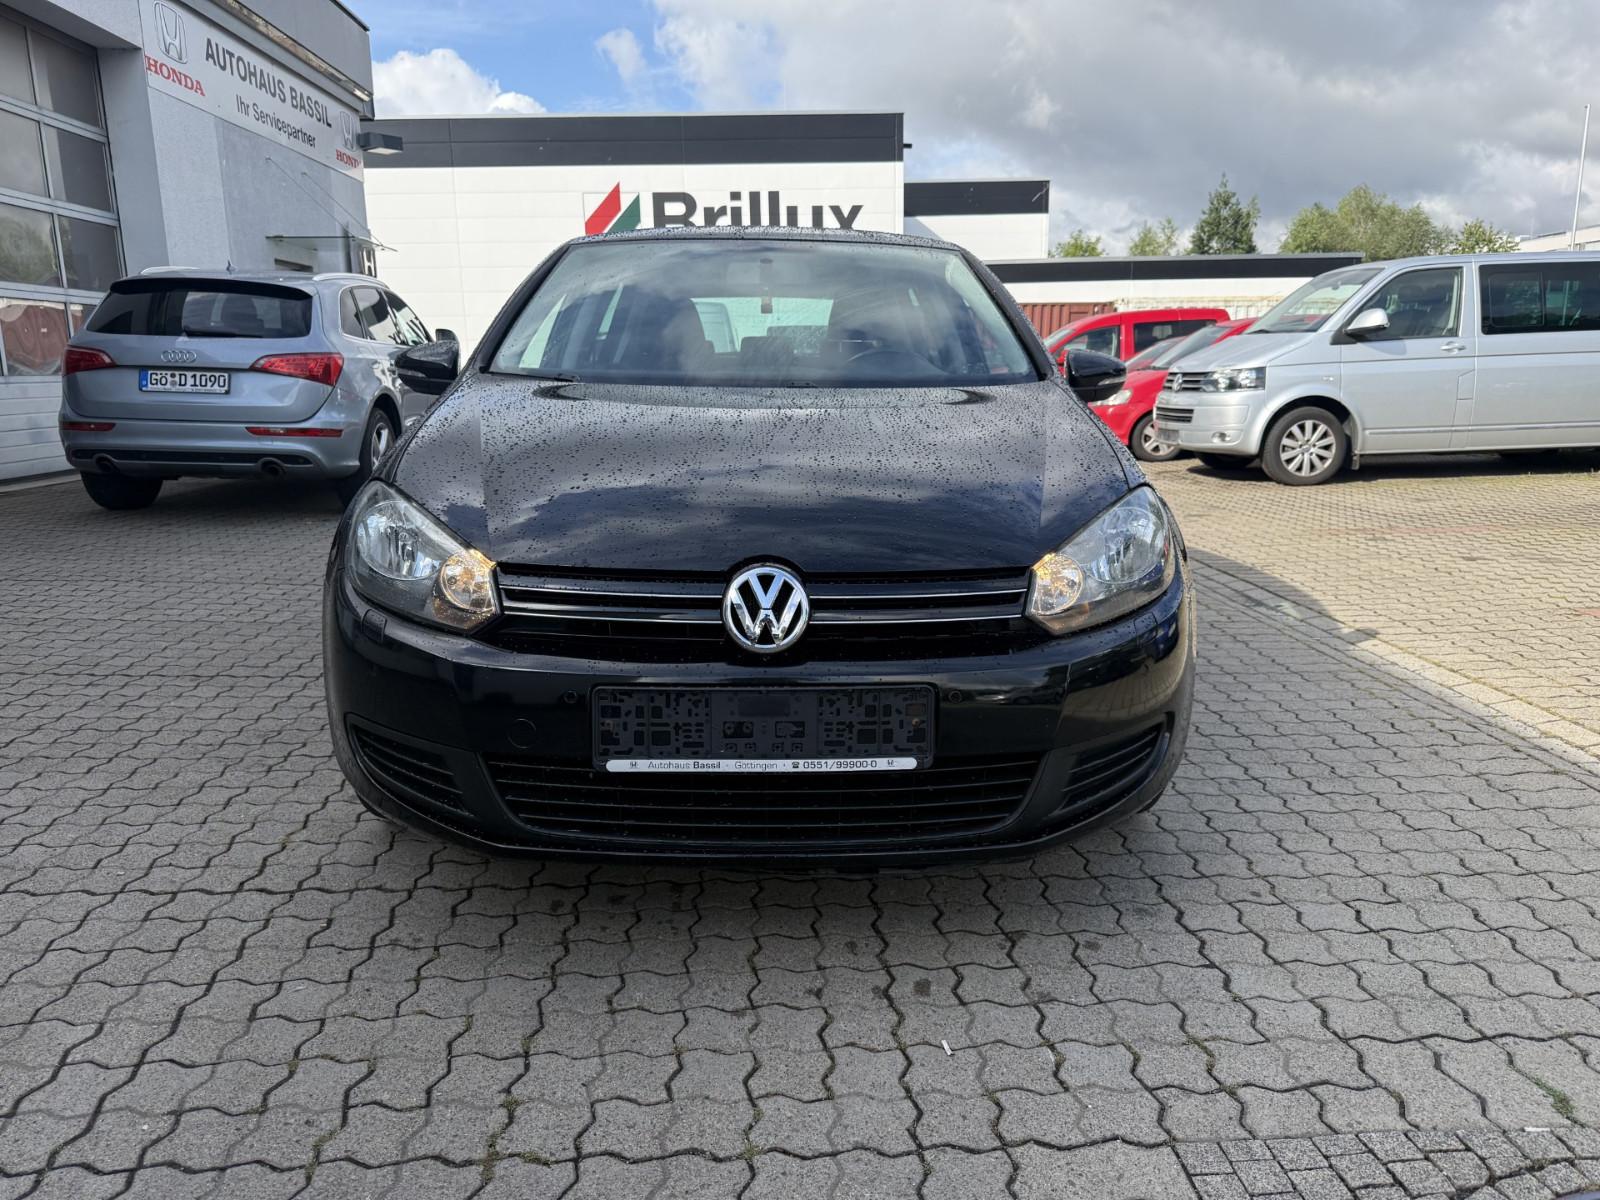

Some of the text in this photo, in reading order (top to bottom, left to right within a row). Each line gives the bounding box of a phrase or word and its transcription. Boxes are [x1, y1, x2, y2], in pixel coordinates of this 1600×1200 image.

[145, 54, 206, 97] HONDA
[205, 37, 332, 128] AUTOHAUS BASSIL
[236, 94, 316, 148] Ihr Servicepartner
[178, 373, 187, 387] D
[190, 374, 227, 388] 1090
[648, 761, 691, 769] Autohaus
[693, 761, 721, 769] Bassil
